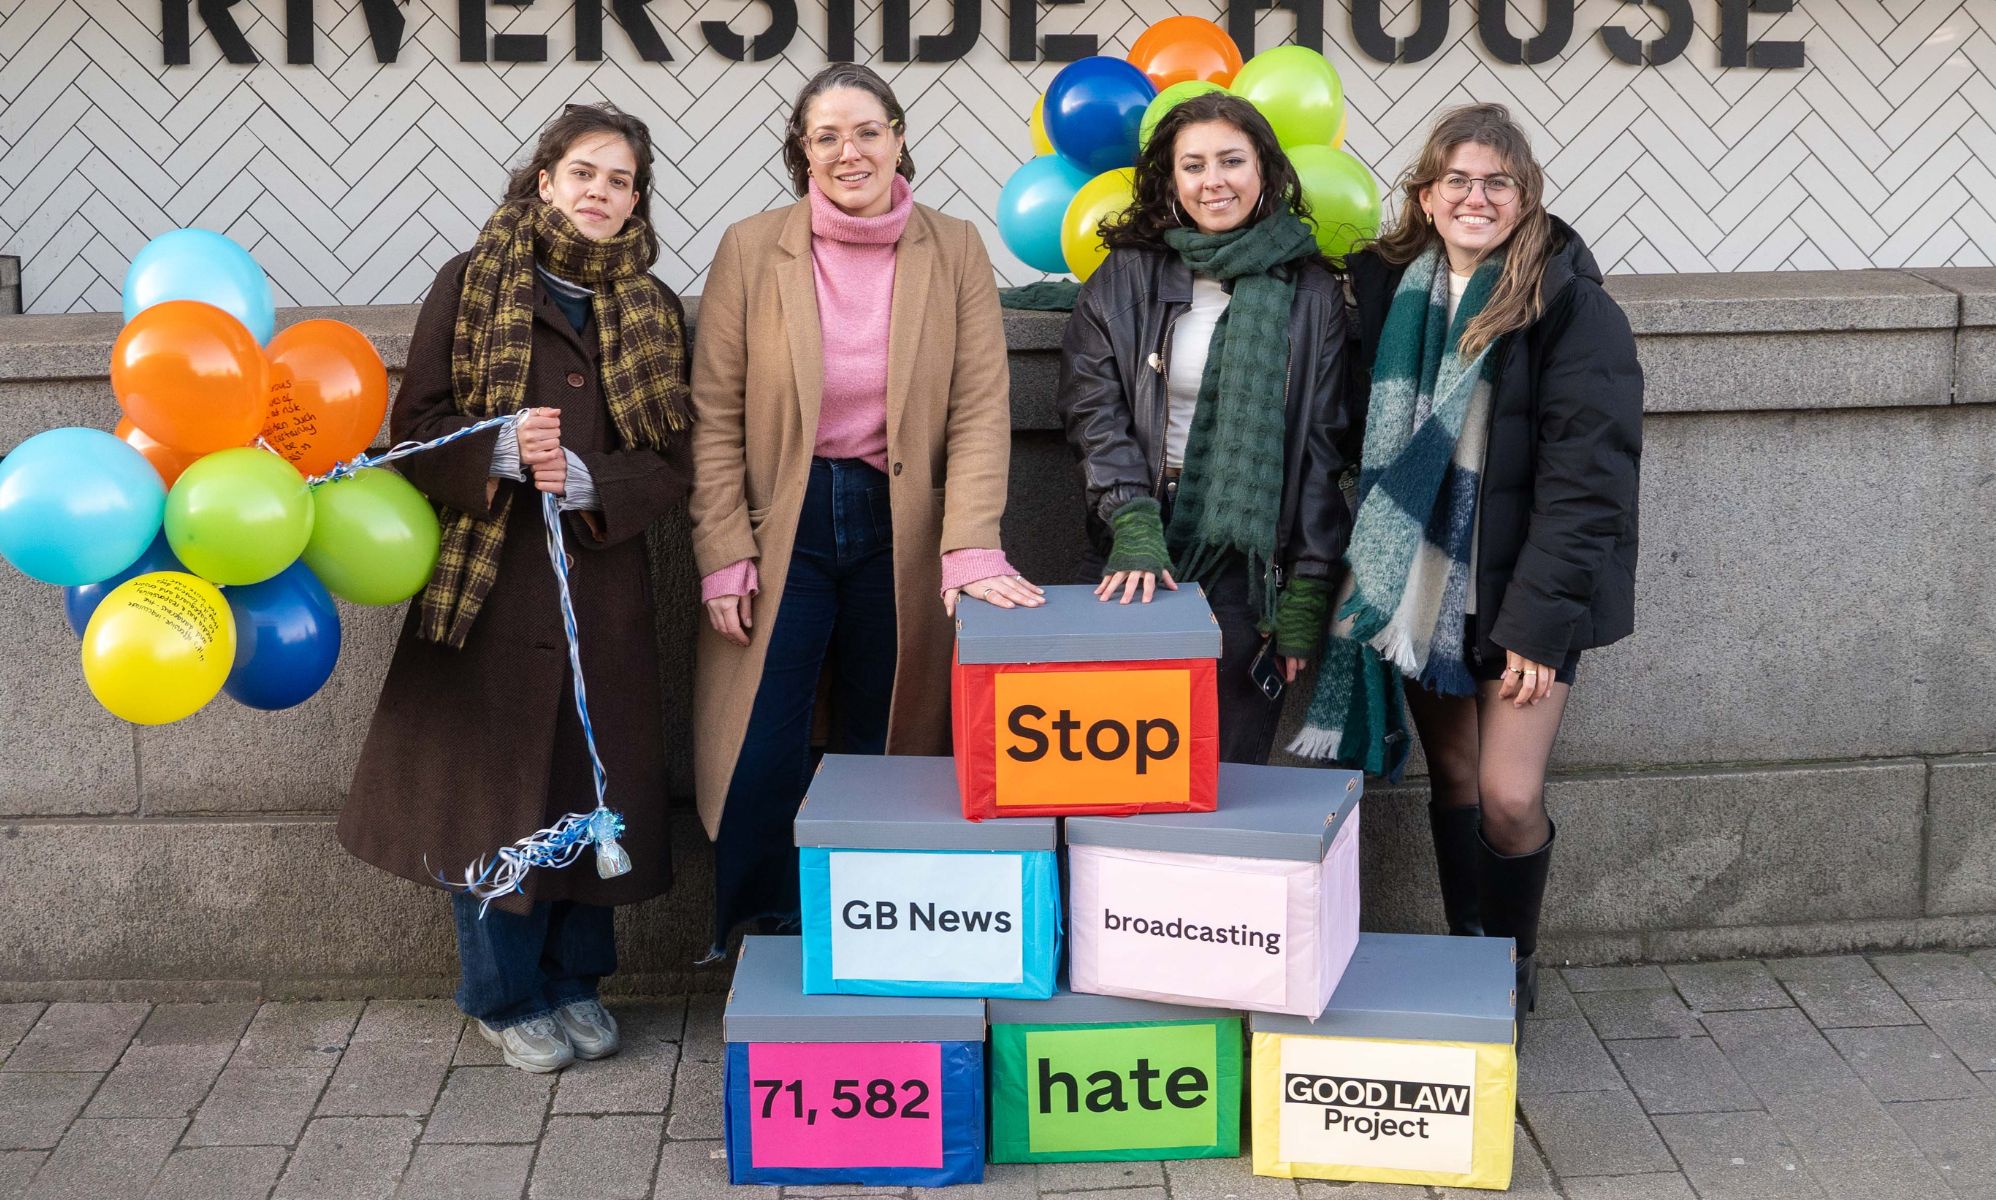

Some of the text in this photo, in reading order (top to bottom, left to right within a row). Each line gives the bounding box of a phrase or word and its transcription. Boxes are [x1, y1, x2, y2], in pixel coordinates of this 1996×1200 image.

[293, 412, 317, 426] such
[1006, 704, 1180, 775] Stop
[842, 900, 1012, 933] GB News
[1105, 908, 1281, 955] broadcasting
[830, 1078, 930, 1120] 582
[1038, 1057, 1209, 1114] hate
[1287, 1076, 1469, 1113] GOOD LAW
[1325, 1107, 1430, 1141] Project
